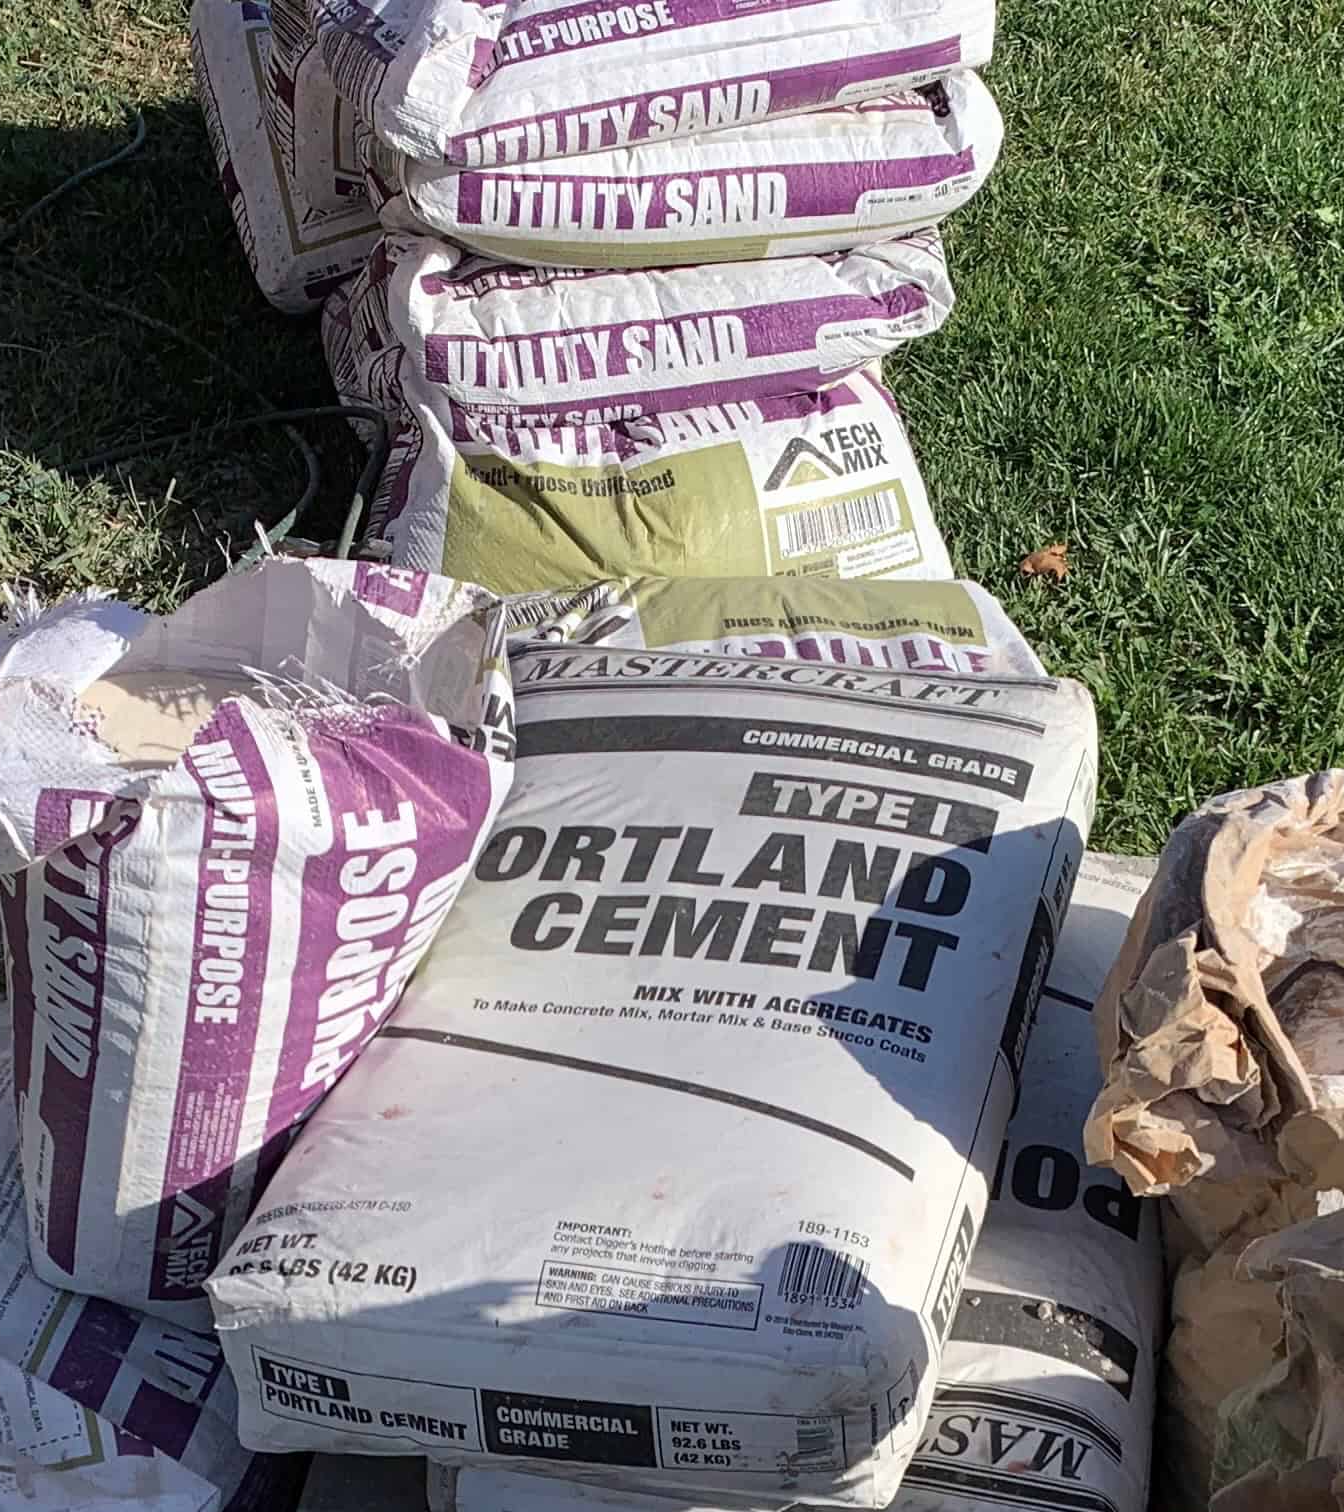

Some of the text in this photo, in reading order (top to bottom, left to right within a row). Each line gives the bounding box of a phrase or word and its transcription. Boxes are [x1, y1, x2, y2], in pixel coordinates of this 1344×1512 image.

[494, 1, 675, 64] LTI-PURPOSE
[464, 80, 771, 166] UTILITY SAND
[481, 172, 788, 232] UTILITY SAND
[447, 315, 748, 389] UTILITY SAND
[820, 422, 883, 453] TECH
[843, 444, 889, 474] MIX
[522, 655, 1001, 707] MASTERCRAFT
[743, 728, 1018, 785] COMMERCIAL GRADE
[300, 769, 313, 783] IN
[306, 786, 322, 828] MADE
[772, 778, 953, 837] TYPE I
[187, 739, 256, 1026] MULTI-PURPOSE
[474, 825, 972, 918] ORTLAND
[510, 892, 959, 993] CEMENT
[44, 925, 97, 1078] SAND
[633, 984, 934, 1045] MIX WITH AGGREGATES
[472, 998, 927, 1064] To Make Concrete Mix, Mortar Mix & Base Stucco Coats
[347, 1199, 377, 1212] ASTM
[236, 1233, 319, 1257] NET WT.
[556, 1220, 632, 1239] IMPORTANT:
[797, 1219, 871, 1249] 189-1153
[183, 1231, 213, 1289] TECH
[550, 1244, 569, 1257] any
[572, 1246, 614, 1260] projects
[616, 1250, 638, 1263] that
[639, 1255, 676, 1268] involve
[553, 1232, 755, 1265] Contact Digger's Hotline before starting
[165, 1247, 185, 1289] MIX
[328, 1260, 369, 1285] (42
[374, 1263, 418, 1293] KG)
[549, 1266, 597, 1281] WARNING:
[601, 1273, 621, 1285] CAN
[622, 1276, 652, 1290] CAUSE
[654, 1279, 692, 1294] SERIOUS
[543, 1291, 649, 1314] AND FIRST AID ON BACK
[544, 1279, 568, 1291] SKIN
[567, 1282, 588, 1294] AND
[618, 1288, 637, 1300] SEE
[638, 1290, 692, 1306] ADDITIONAL
[691, 1295, 755, 1313] PRECAUTIONS
[783, 1292, 856, 1311] 1891 1534
[270, 1362, 336, 1397] TYPE I
[265, 1383, 469, 1441] PORTLAND CEMENT
[496, 1405, 640, 1436] COMMERCIAL
[670, 1420, 733, 1436] NET WT.
[498, 1428, 570, 1450] GRADE
[671, 1436, 741, 1452] 92.6 LBS
[673, 1452, 731, 1467] (42 KG)
